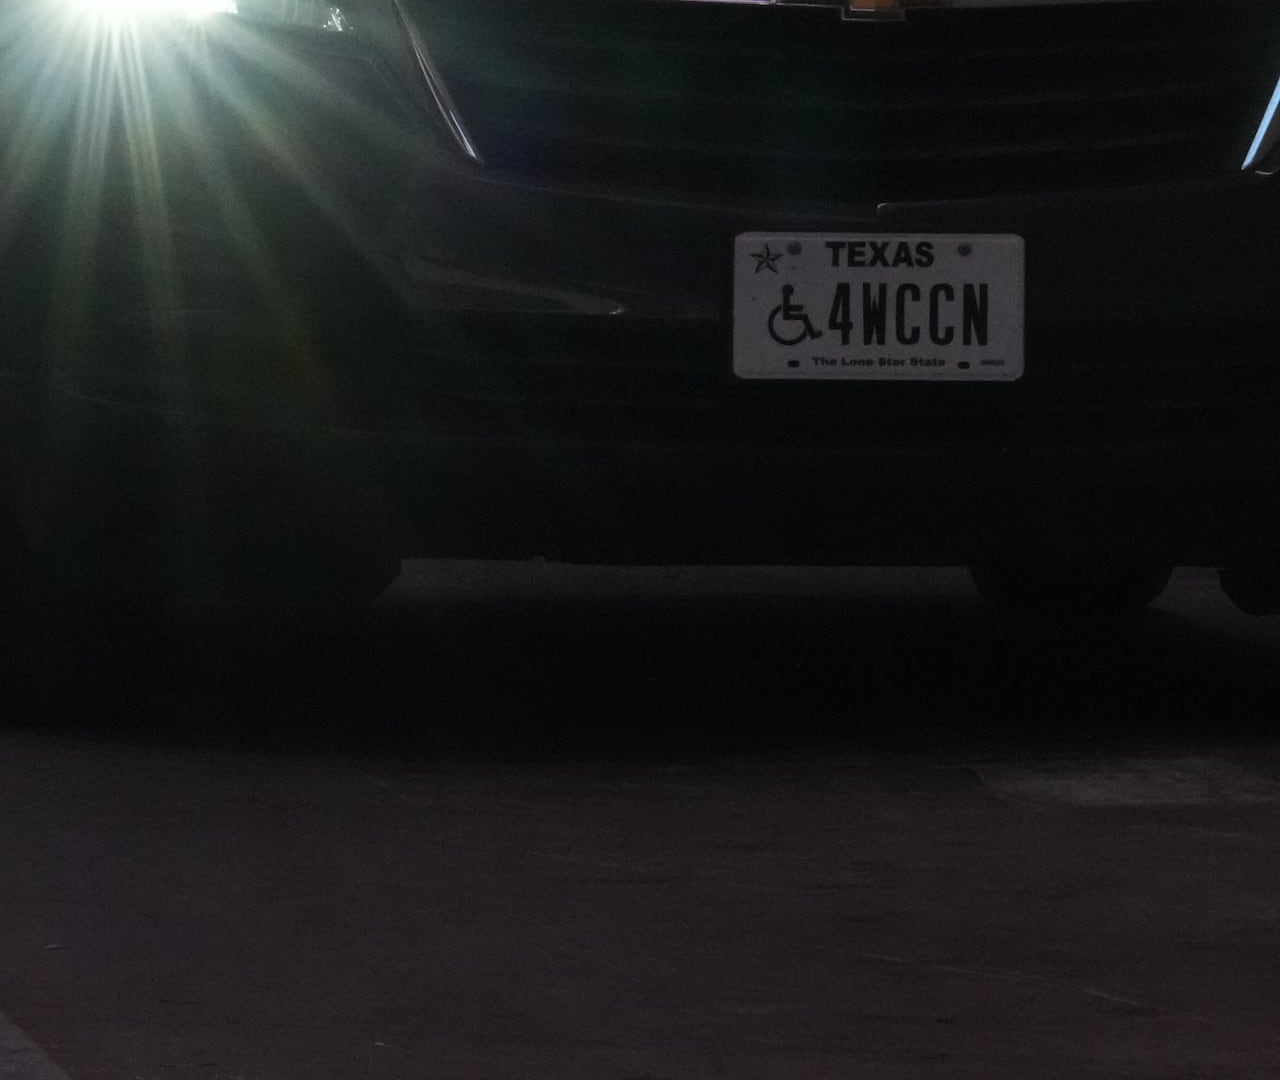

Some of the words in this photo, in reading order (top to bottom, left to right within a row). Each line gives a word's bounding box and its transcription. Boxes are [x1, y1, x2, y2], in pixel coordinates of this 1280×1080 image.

[826, 241, 934, 268] TEXAS
[828, 282, 989, 345] 4WCCN
[813, 357, 837, 367] The
[842, 357, 874, 367] Lone
[879, 357, 906, 367] Star
[910, 357, 946, 367] State
